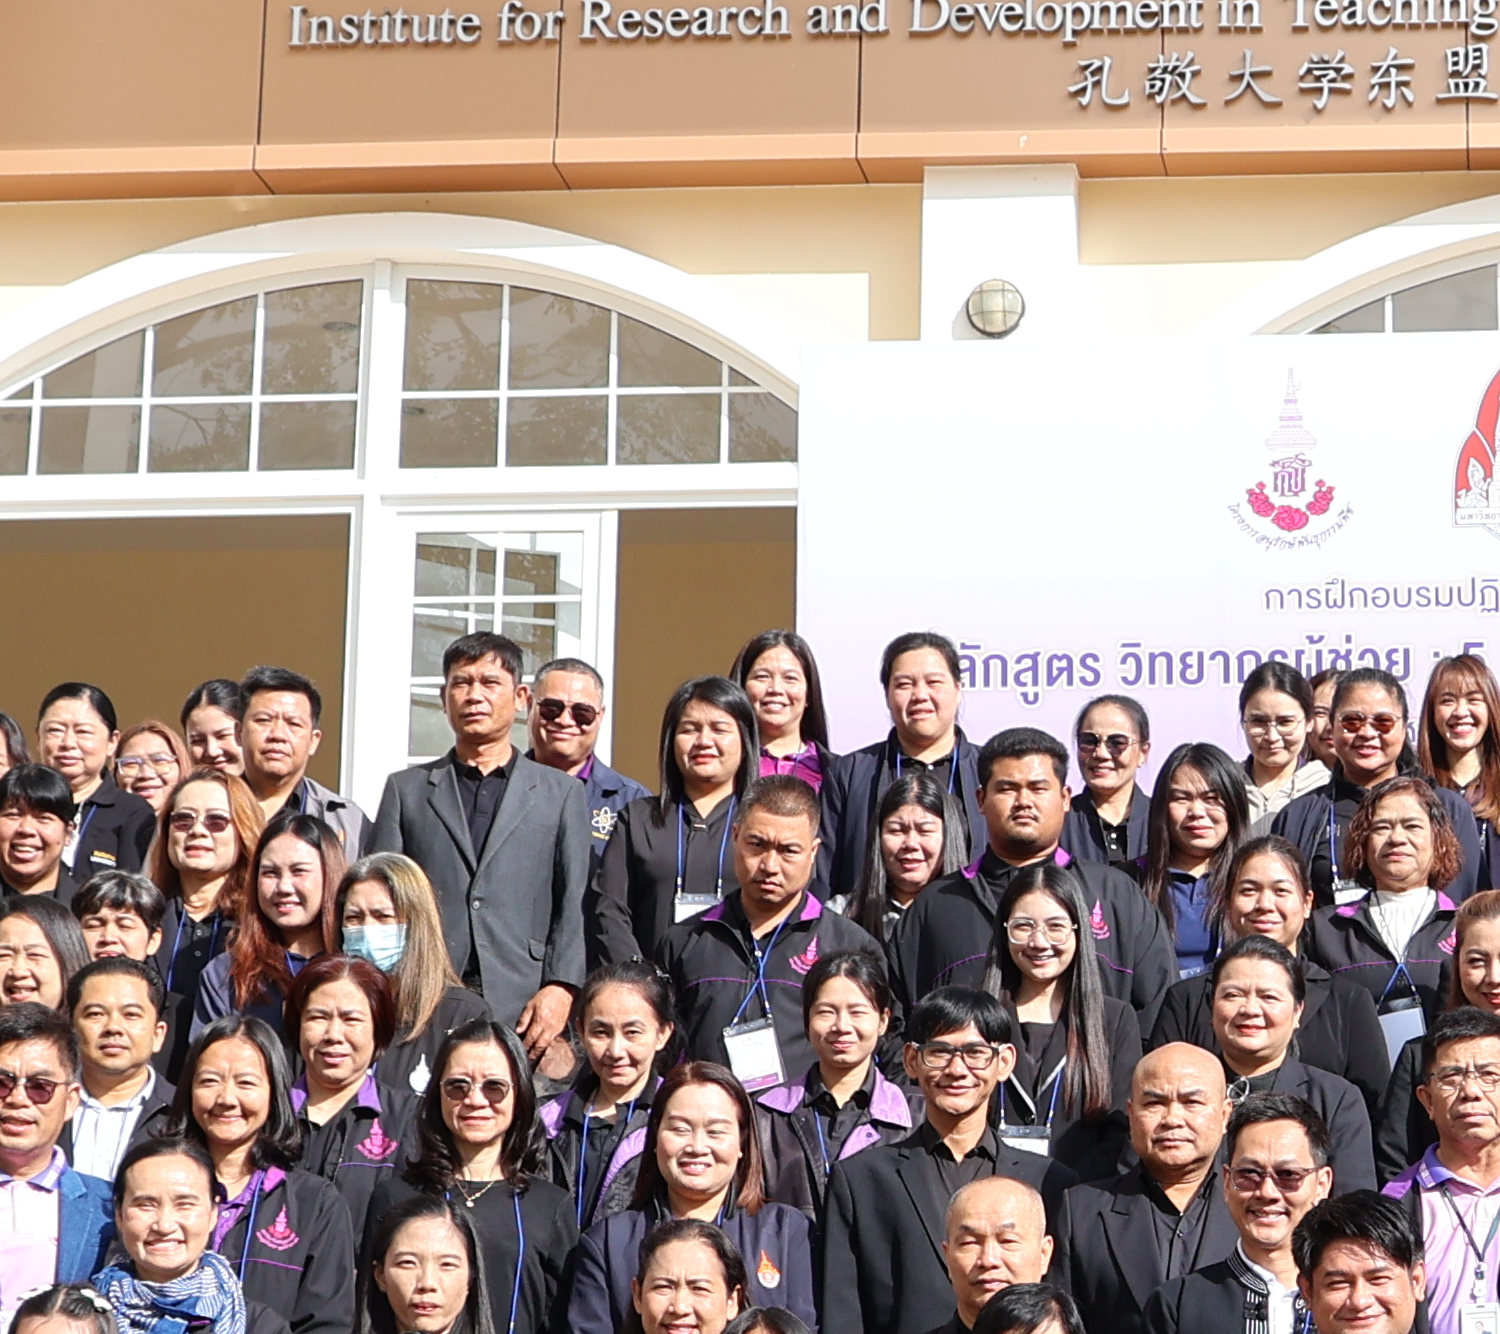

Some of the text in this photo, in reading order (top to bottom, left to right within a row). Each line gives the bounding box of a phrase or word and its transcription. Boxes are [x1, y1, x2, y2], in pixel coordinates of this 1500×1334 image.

[288, 4, 481, 46] Institute
[957, 641, 1101, 705] ลักสูตร
